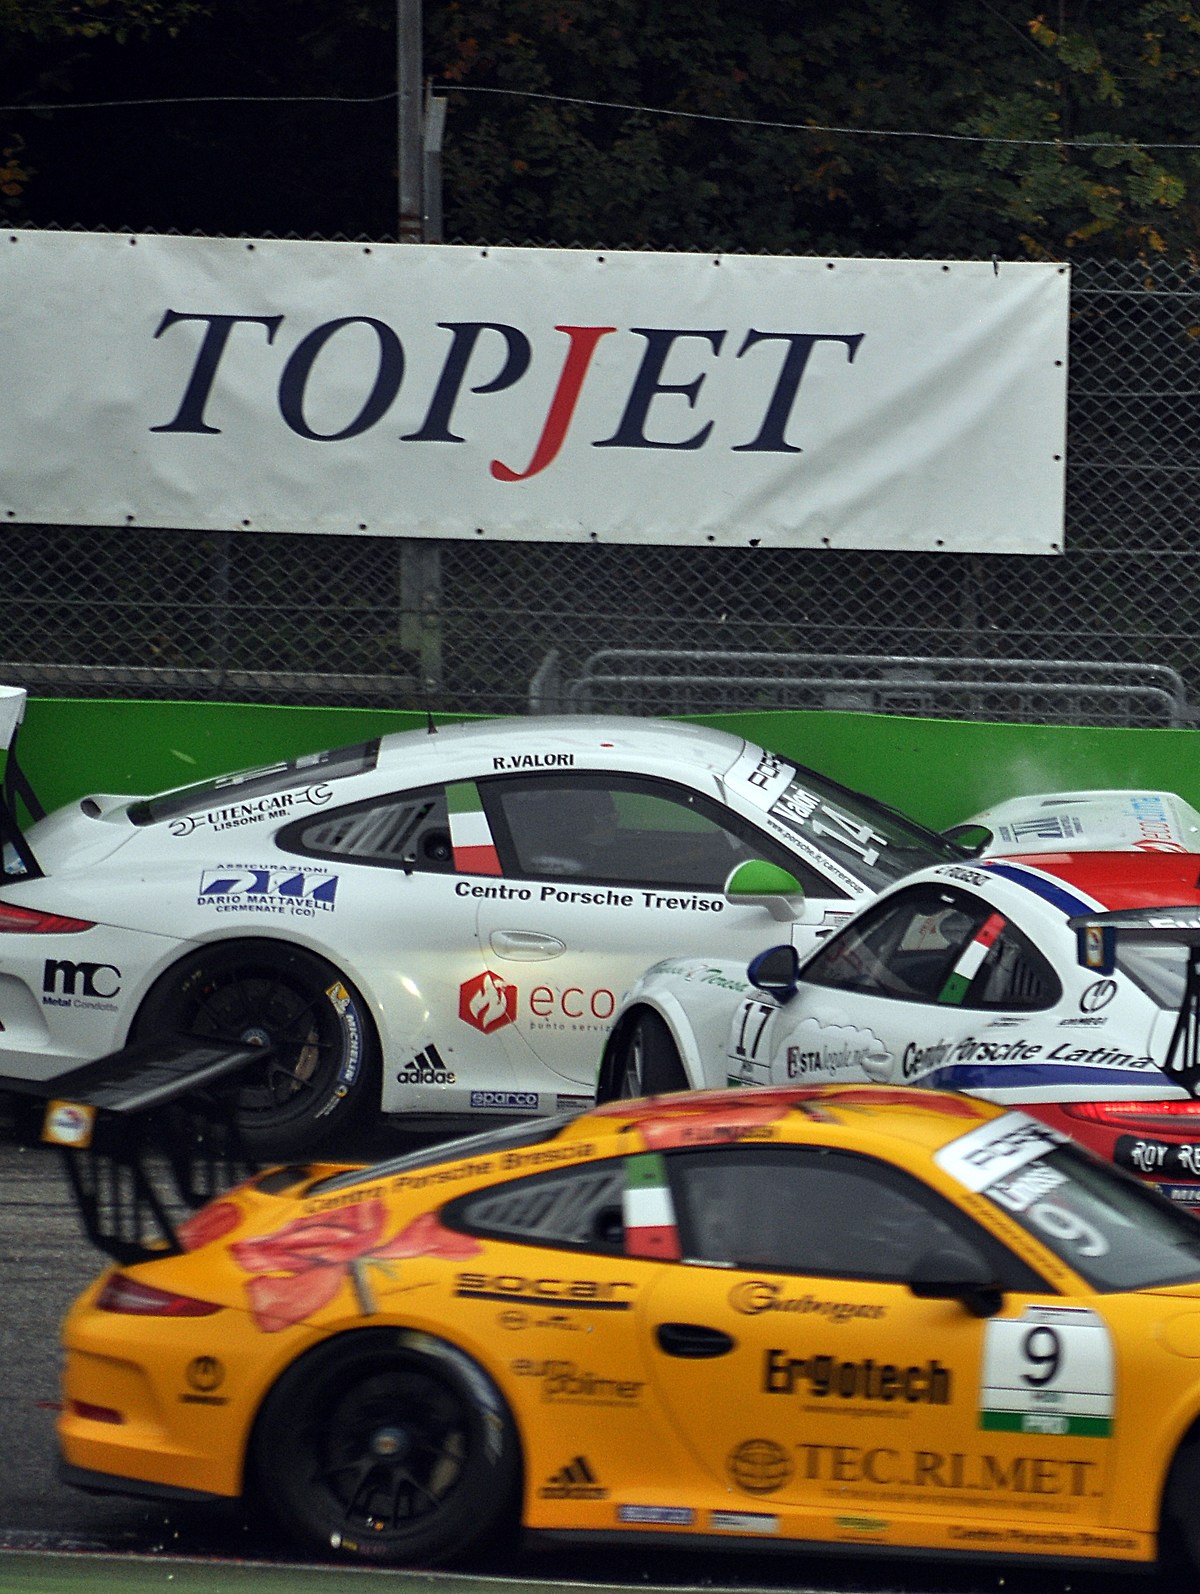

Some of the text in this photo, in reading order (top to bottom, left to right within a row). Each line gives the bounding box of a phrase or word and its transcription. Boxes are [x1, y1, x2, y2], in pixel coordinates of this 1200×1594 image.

[149, 308, 866, 482] TOPJET
[493, 754, 575, 770] R.VALORI
[208, 794, 293, 825] UTEN-CAR
[214, 814, 266, 831] LISSONE
[812, 805, 888, 867] 14
[217, 864, 329, 874] ASSICURAZIONI
[197, 895, 336, 912] DARIO MATTAVELLI
[216, 905, 316, 918] CERMENATE (CO)
[455, 881, 725, 913] Centro Porsche Treviso
[42, 996, 72, 1008] Metal
[529, 985, 616, 1019] eco
[529, 1021, 566, 1031] punto
[736, 1002, 776, 1059] 17
[344, 1013, 359, 1082] MICHELIN
[953, 1036, 1043, 1062] Porsche
[1046, 1042, 1155, 1069] Latina
[397, 1068, 456, 1086] adidas
[471, 1091, 538, 1107] sparco
[1131, 1141, 1169, 1173] ROY
[1028, 1203, 1109, 1257] 9
[457, 1273, 635, 1299] socar
[1020, 1326, 1062, 1387] 9
[763, 1348, 952, 1405] Ergotech
